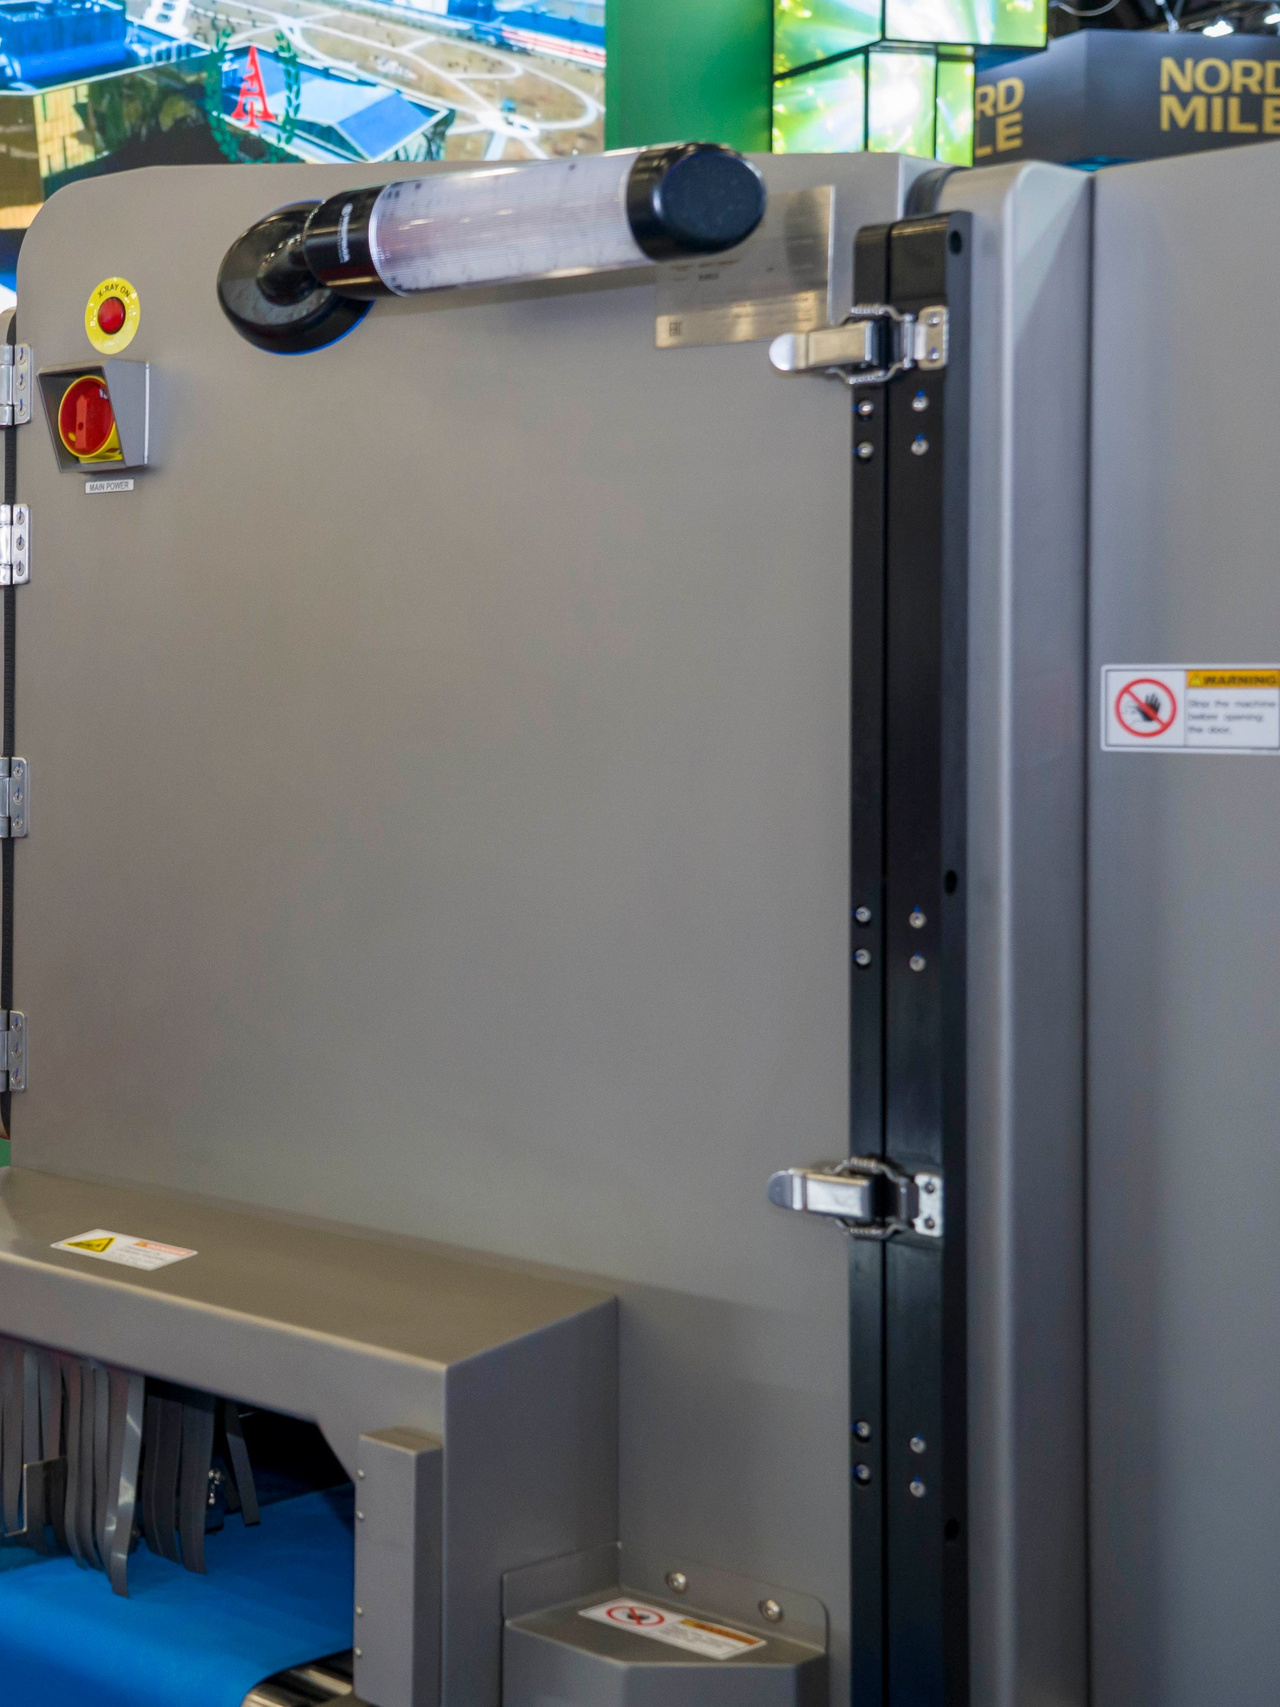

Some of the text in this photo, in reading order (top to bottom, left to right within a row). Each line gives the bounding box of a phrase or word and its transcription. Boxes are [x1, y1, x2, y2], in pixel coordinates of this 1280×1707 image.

[98, 283, 130, 298] X-RAY ON
[90, 481, 129, 491] MAIN POWER
[1204, 676, 1277, 685] WARNING
